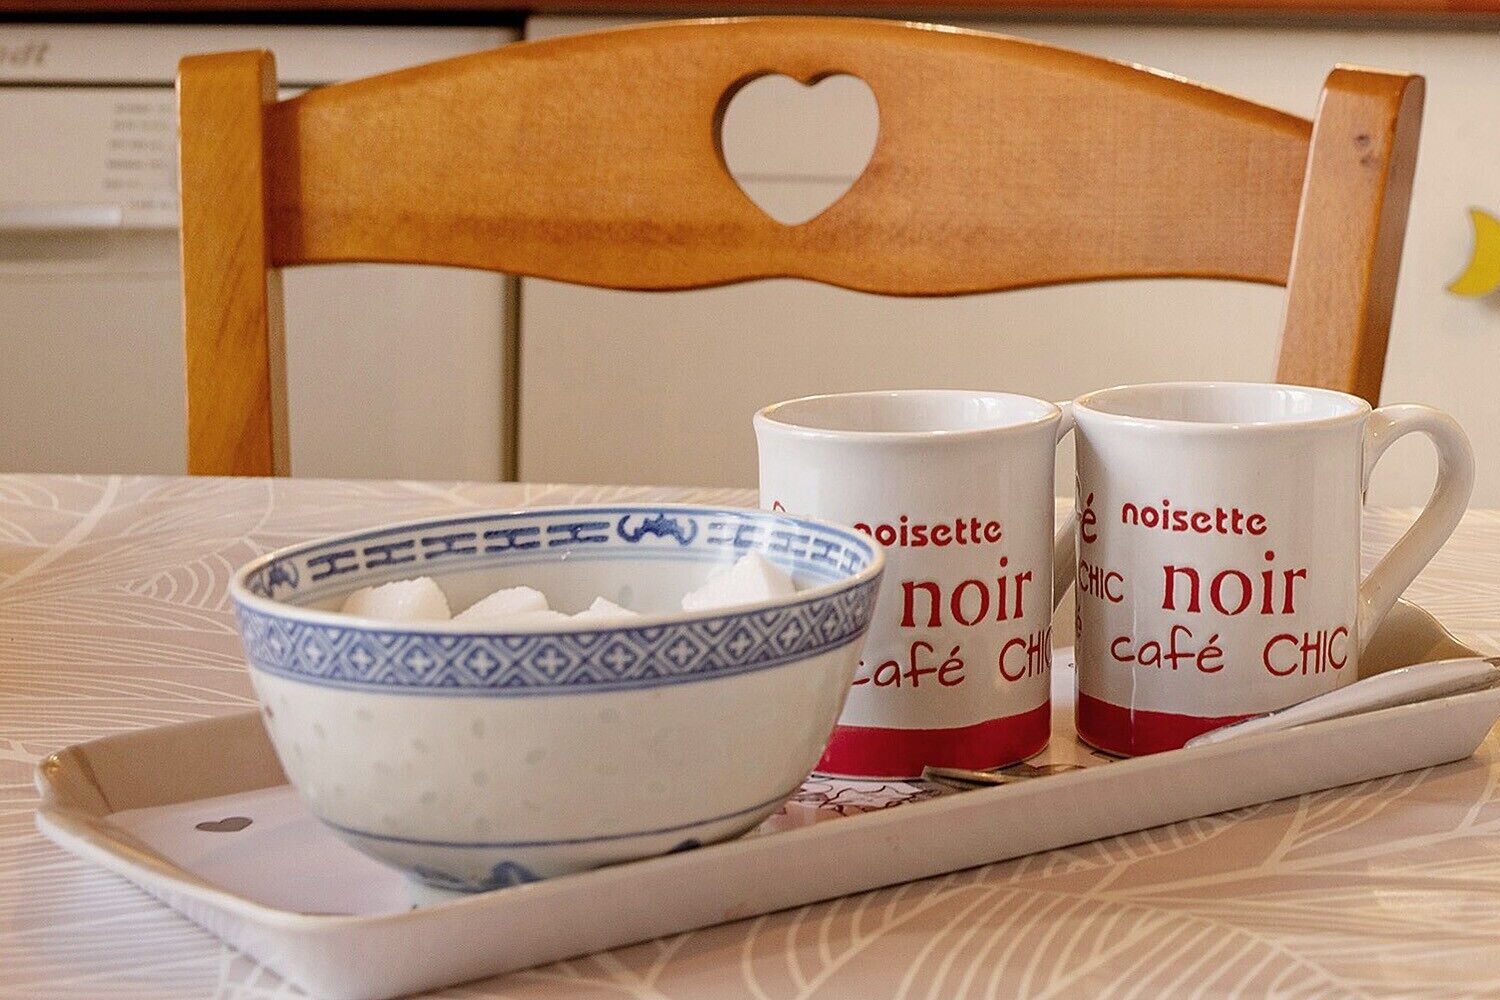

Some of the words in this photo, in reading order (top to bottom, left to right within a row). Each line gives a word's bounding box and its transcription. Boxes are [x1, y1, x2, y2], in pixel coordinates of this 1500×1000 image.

[1122, 500, 1267, 535] noisette
[901, 557, 1032, 627] noir
[1079, 560, 1124, 603] CHIC
[1162, 550, 1306, 616] noir
[852, 640, 965, 687] afé
[1110, 624, 1223, 673] café
[1263, 626, 1348, 676] CHIC
